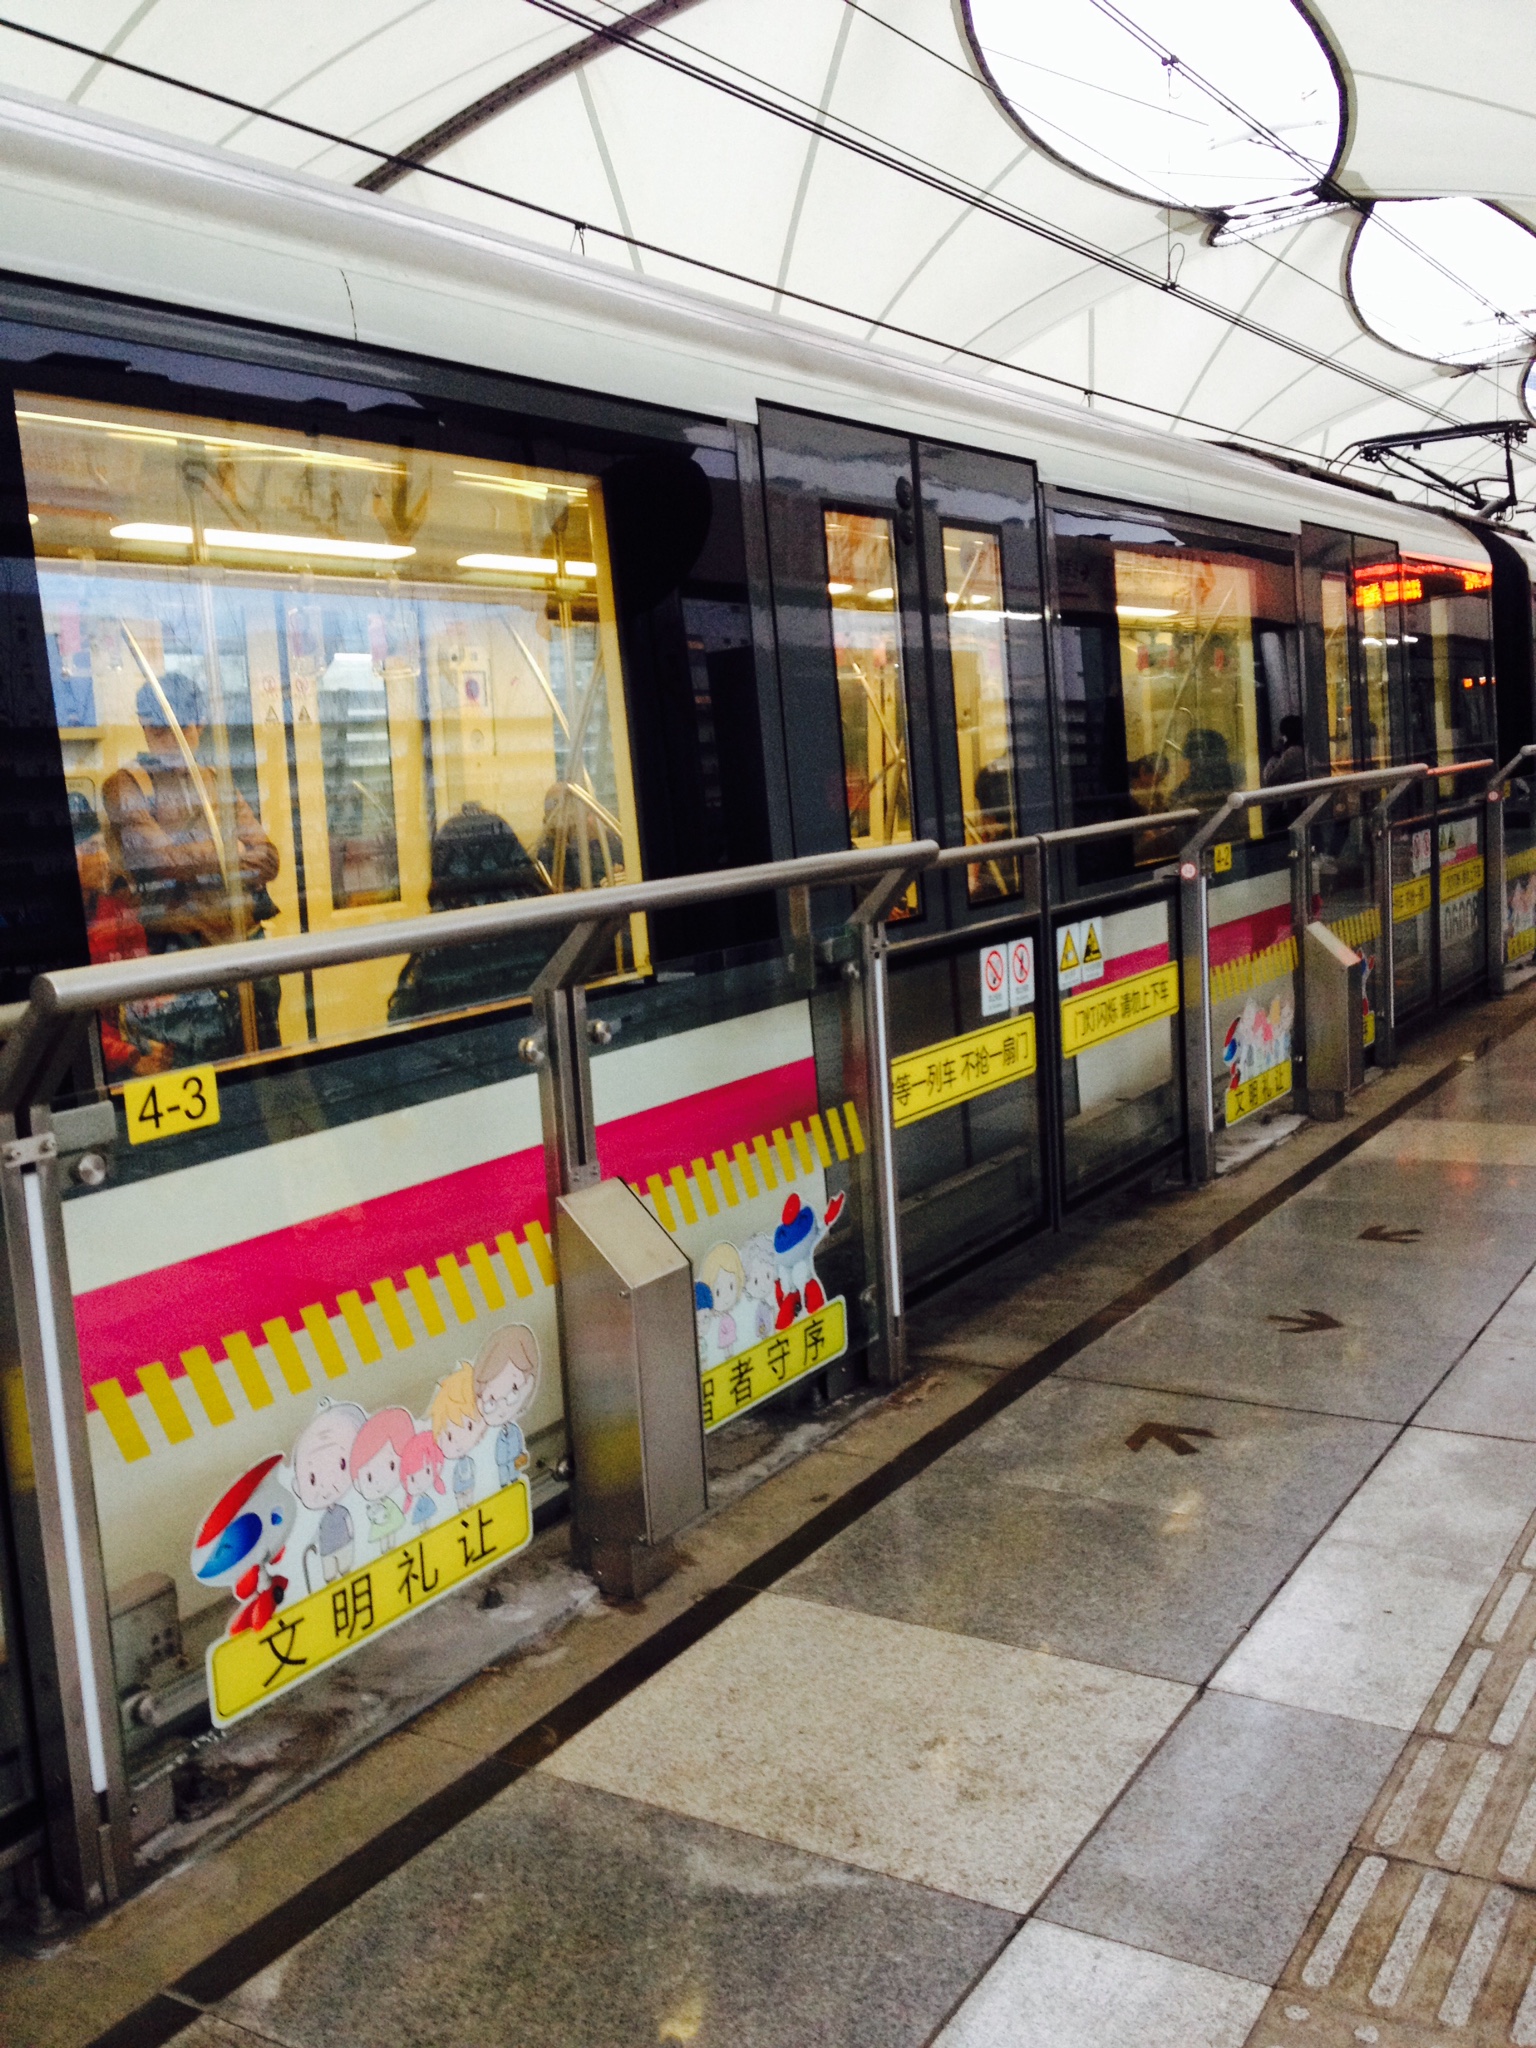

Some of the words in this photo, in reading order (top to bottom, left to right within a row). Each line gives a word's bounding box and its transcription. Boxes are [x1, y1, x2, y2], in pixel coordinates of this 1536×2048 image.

[961, 1031, 1029, 1083] 不抢一扇门
[138, 1076, 207, 1129] 4-3
[258, 1509, 498, 1689] 文明礼让
